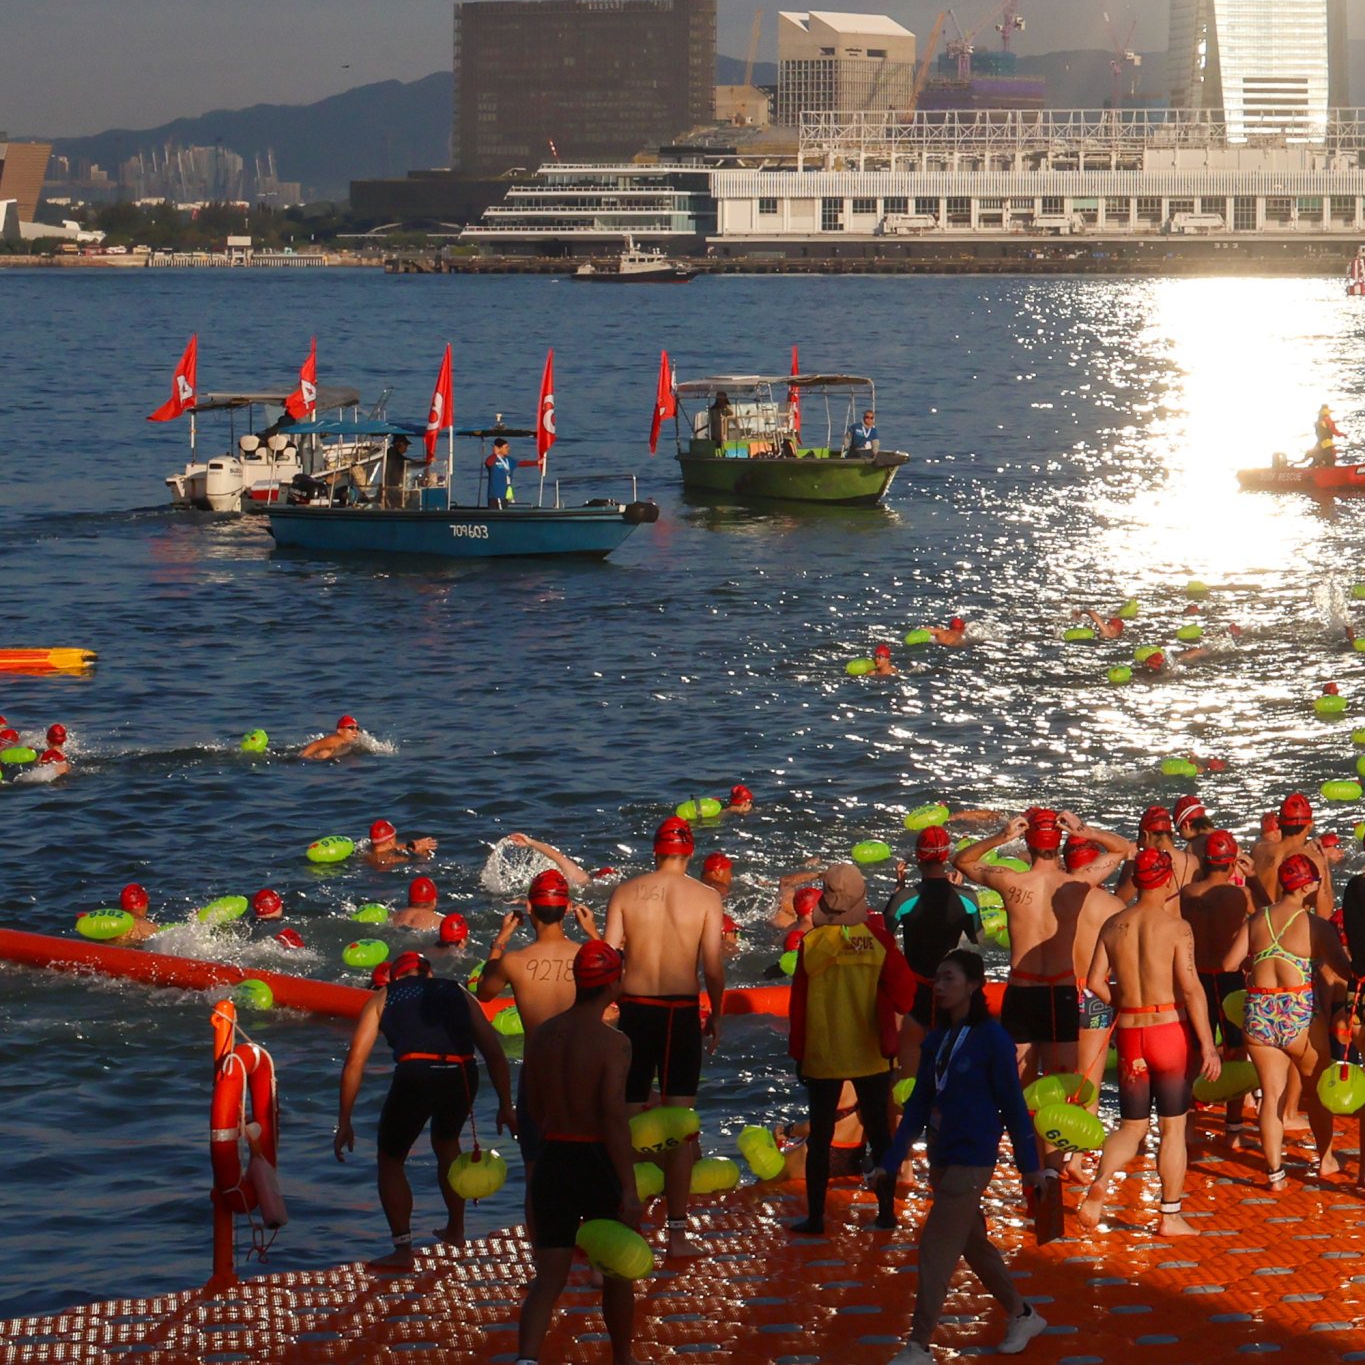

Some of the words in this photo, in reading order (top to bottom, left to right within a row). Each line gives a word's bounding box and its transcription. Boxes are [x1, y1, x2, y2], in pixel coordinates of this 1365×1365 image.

[449, 524, 489, 539] 709603
[1008, 886, 1034, 906] 9315
[526, 959, 574, 982] 9278
